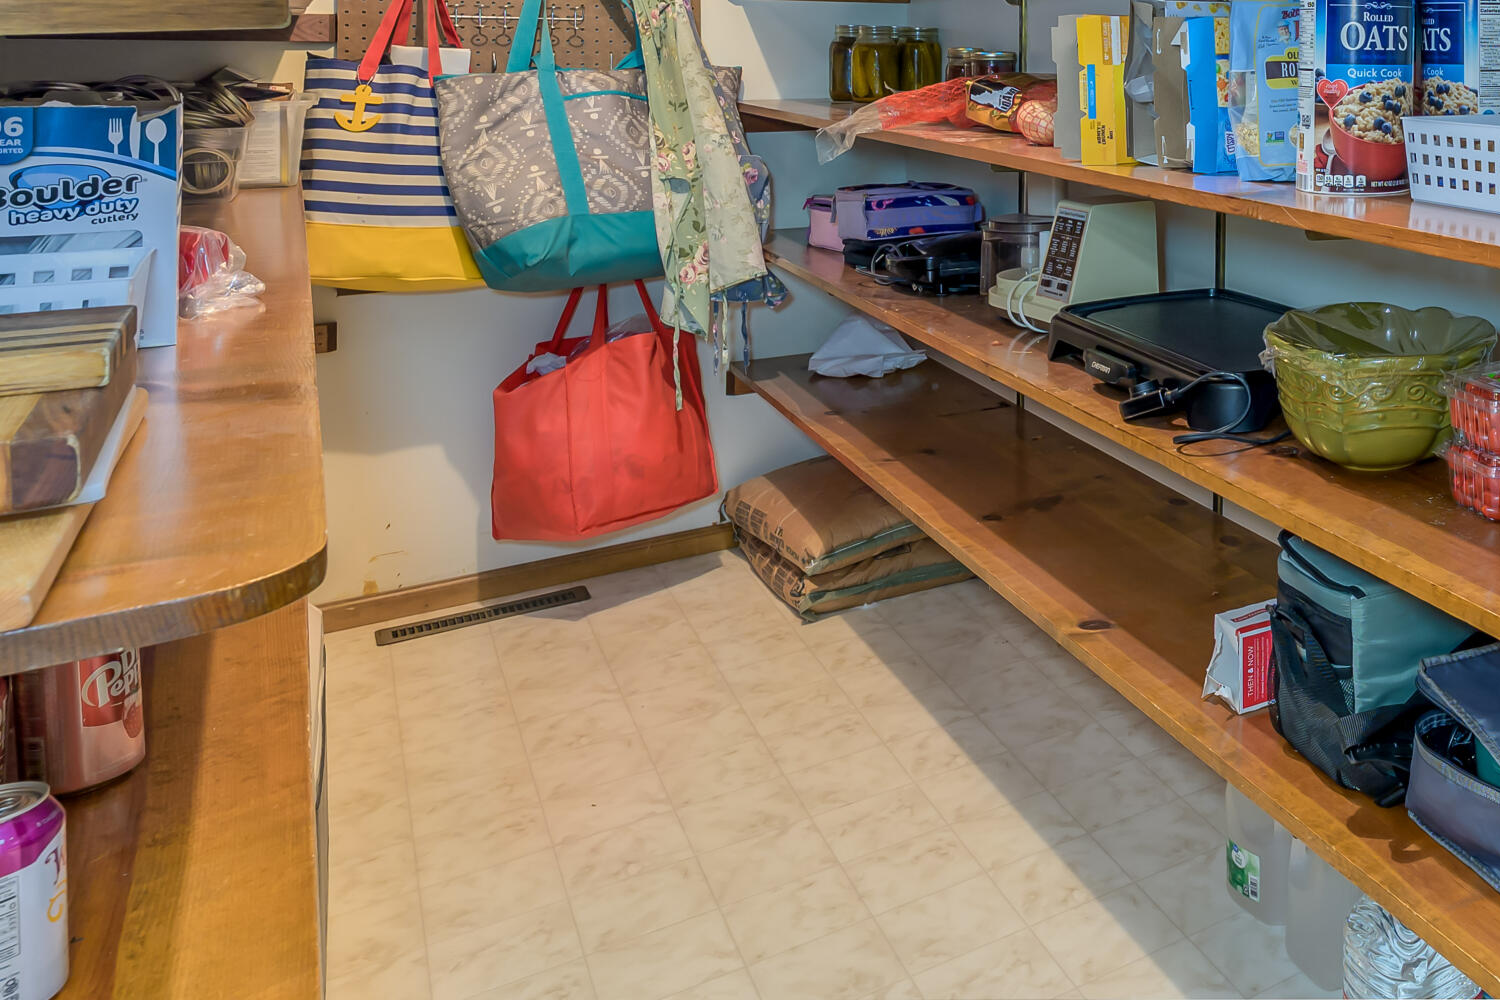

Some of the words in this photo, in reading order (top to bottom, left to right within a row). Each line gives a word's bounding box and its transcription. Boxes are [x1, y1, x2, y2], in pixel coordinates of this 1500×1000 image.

[1363, 11, 1394, 22] ROLLED
[1341, 22, 1408, 51] OATS
[1348, 68, 1378, 78] Quick
[1380, 69, 1402, 77] Cook
[1426, 68, 1444, 76] Cook
[9, 205, 82, 226] heavy
[89, 198, 139, 217] duty
[91, 212, 138, 225] cutlery
